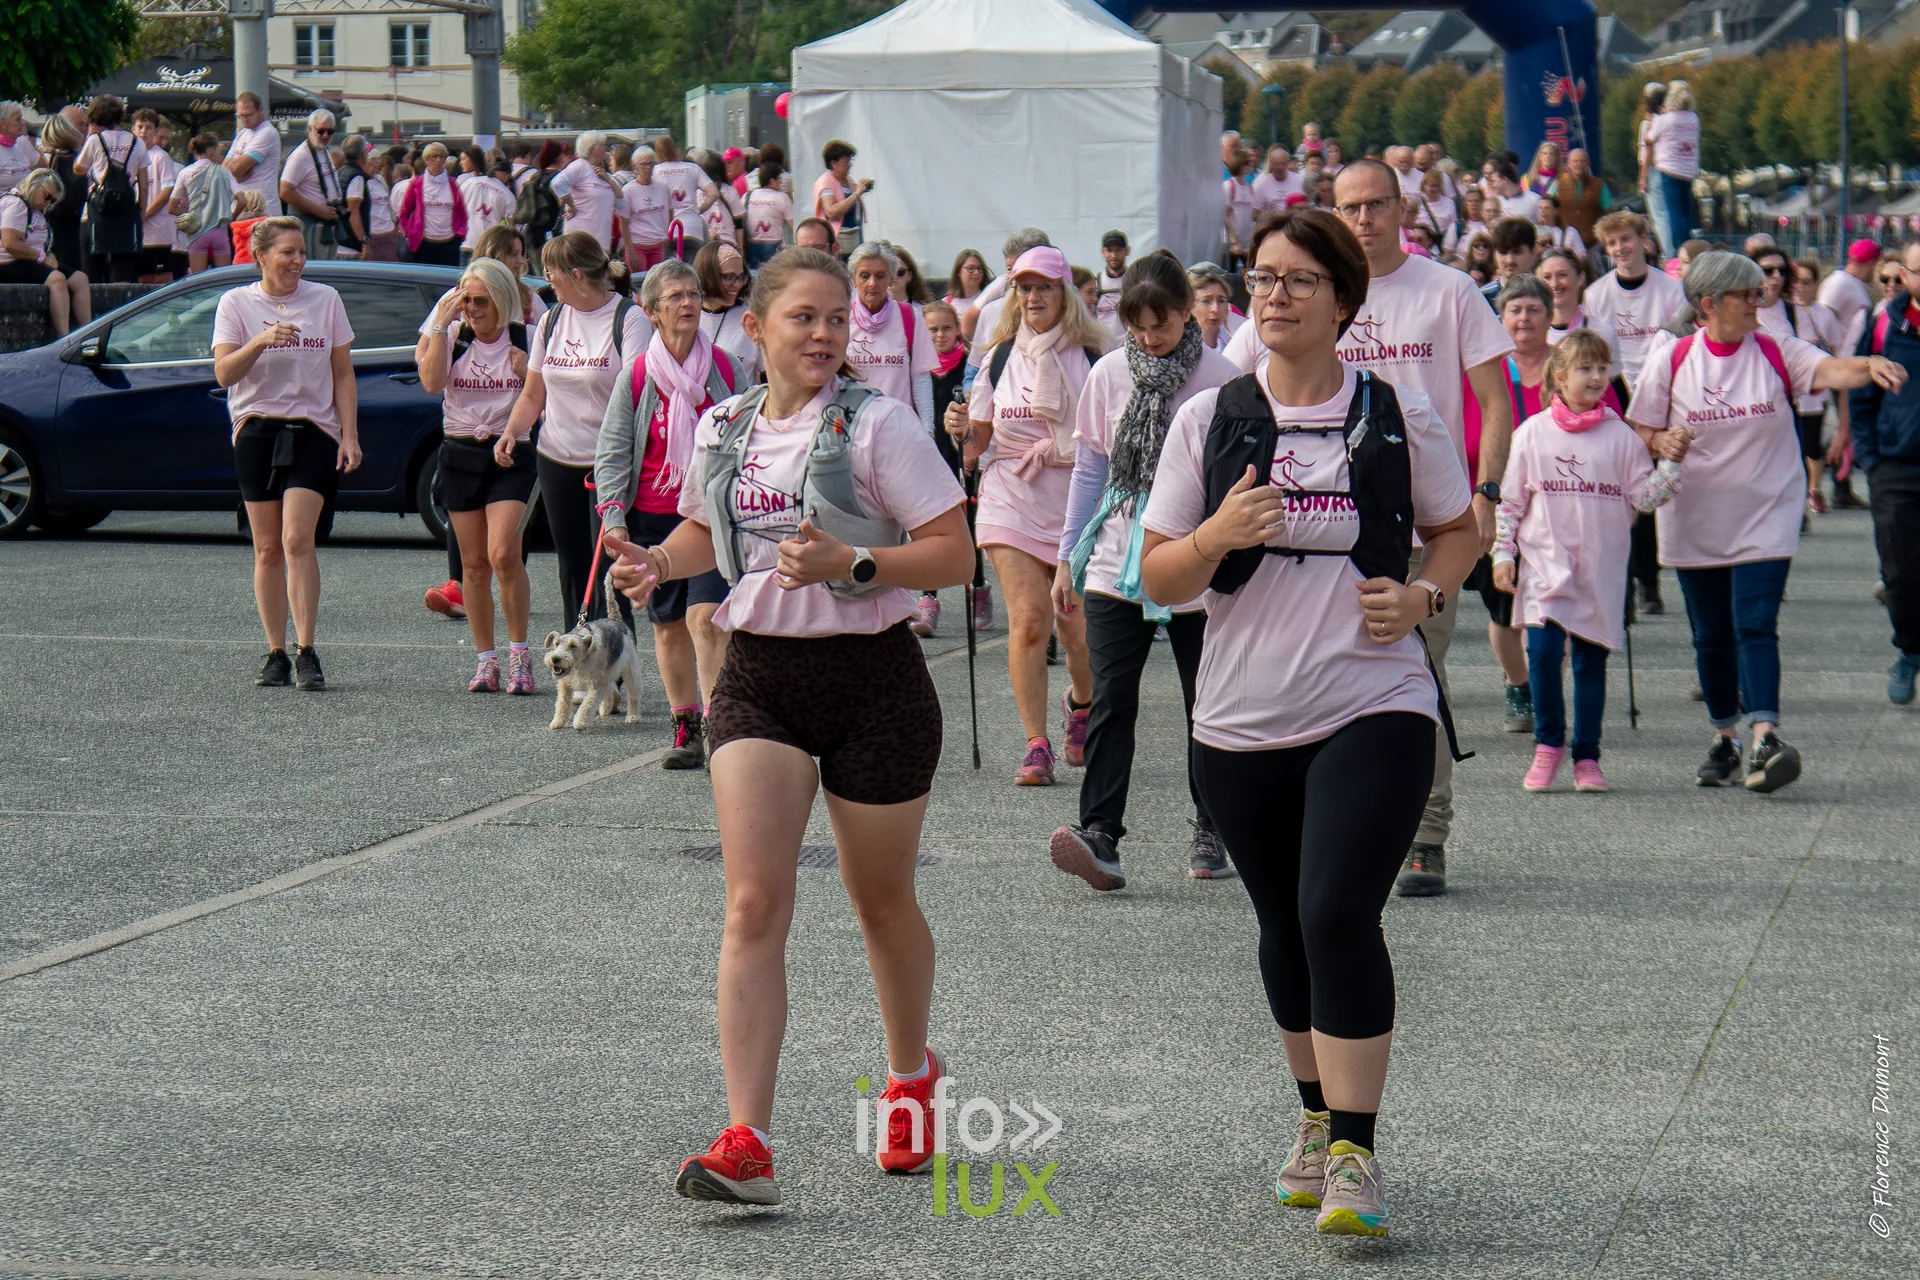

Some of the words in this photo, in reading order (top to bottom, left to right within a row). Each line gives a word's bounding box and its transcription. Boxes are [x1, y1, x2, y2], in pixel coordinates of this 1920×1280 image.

[136, 82, 220, 92] ROCHEHAUT
[303, 338, 325, 348] ROSE
[1336, 344, 1397, 362] OUILLON
[1402, 342, 1433, 358] ROSE
[587, 357, 609, 367] ROSE
[885, 355, 904, 364] ROSE
[453, 377, 503, 389] BOUILLON
[1001, 406, 1034, 419] BOUIL
[1598, 482, 1622, 496] ROSE
